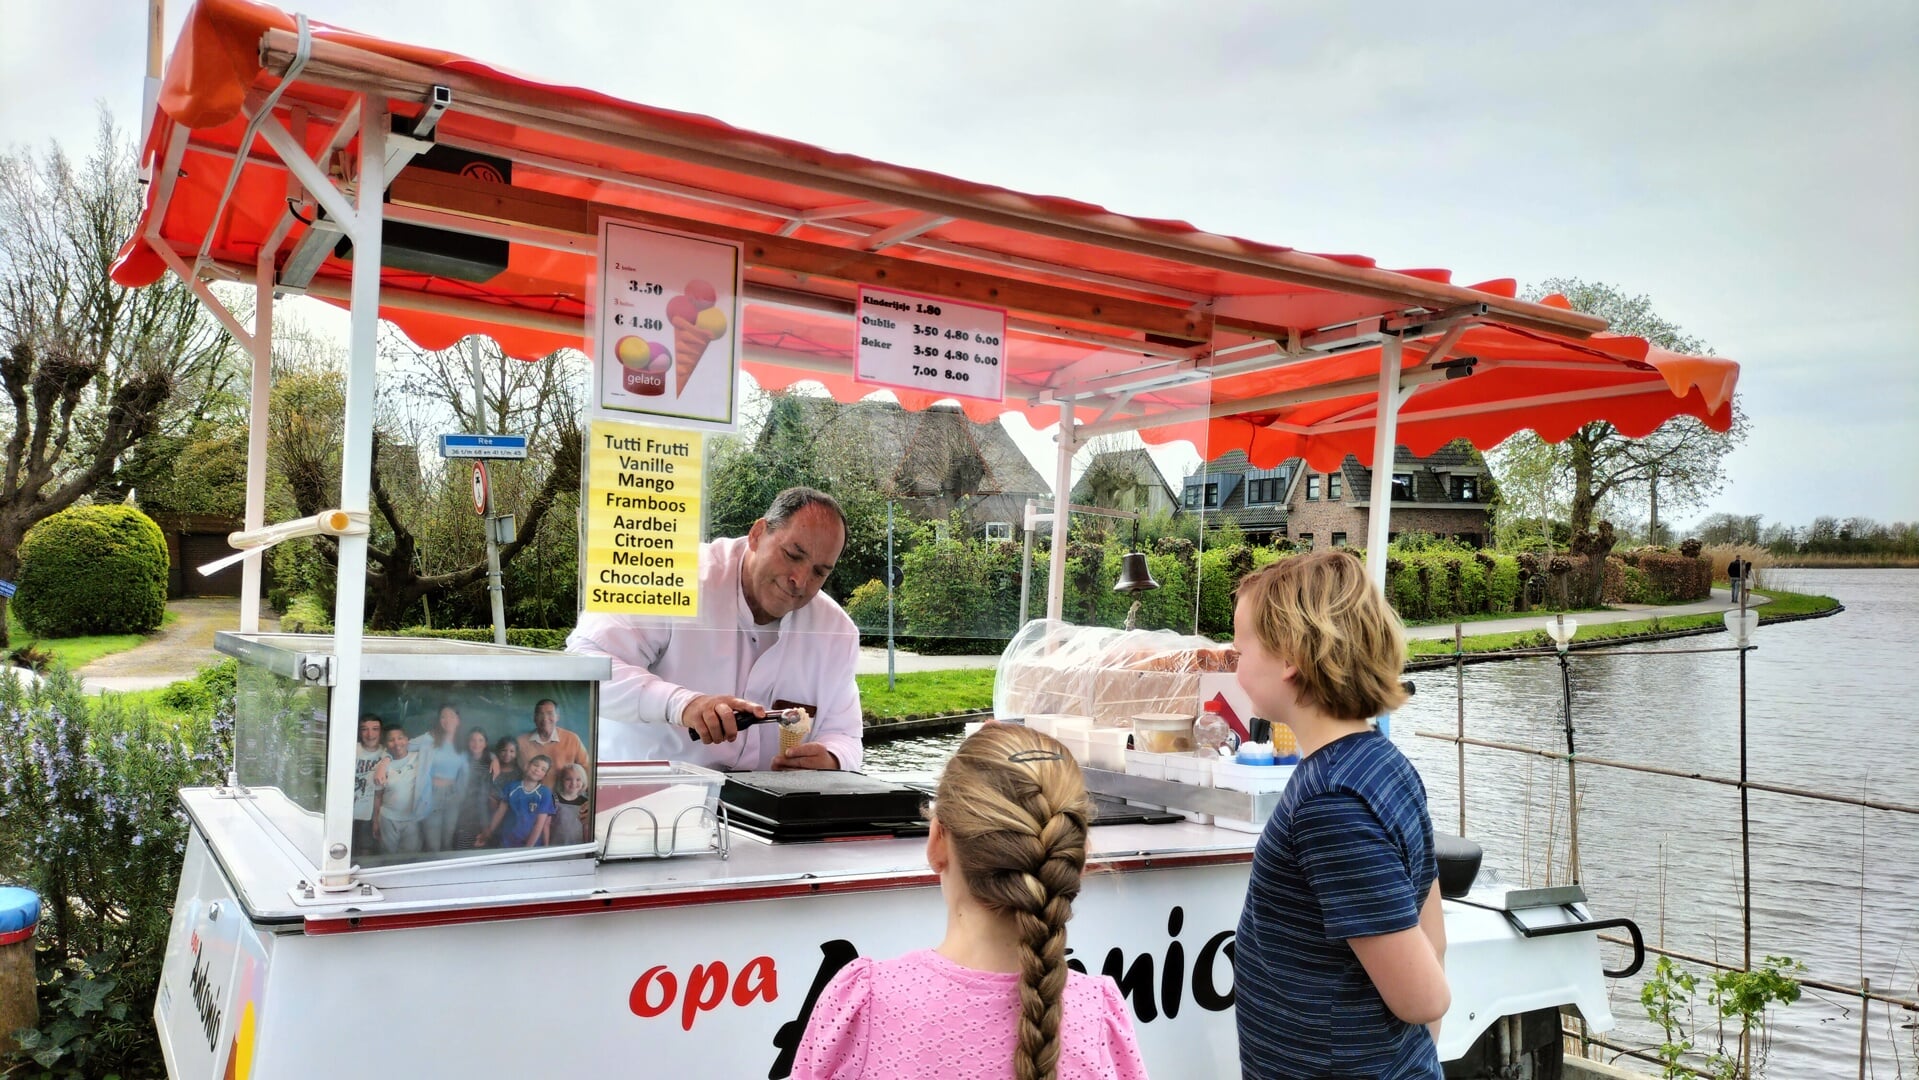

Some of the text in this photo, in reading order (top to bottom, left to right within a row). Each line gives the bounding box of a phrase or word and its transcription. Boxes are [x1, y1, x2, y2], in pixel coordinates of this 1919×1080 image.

[615, 262, 621, 270] 2
[629, 280, 663, 296] 3.50
[863, 296, 942, 316] Kinderijsje 1.80
[614, 313, 624, 326] €
[862, 316, 999, 346] Oublie 3.50 4.80 6.00
[861, 337, 998, 366] Beker 3.50 4.80 6.00
[627, 374, 661, 386] gelato
[912, 365, 970, 382] 7.00 8.00
[604, 434, 689, 457] Tutti Frutti
[619, 455, 674, 473] Vanille
[618, 473, 674, 493] Mango
[606, 493, 686, 513] Framboos
[613, 515, 677, 532] Aardbei
[615, 533, 673, 549] Citroen
[613, 551, 674, 568] Meloen
[600, 569, 684, 587] Chocolade
[592, 588, 690, 606] Stracciatella
[190, 941, 221, 1053] Antonio
[629, 956, 778, 1031] opa
